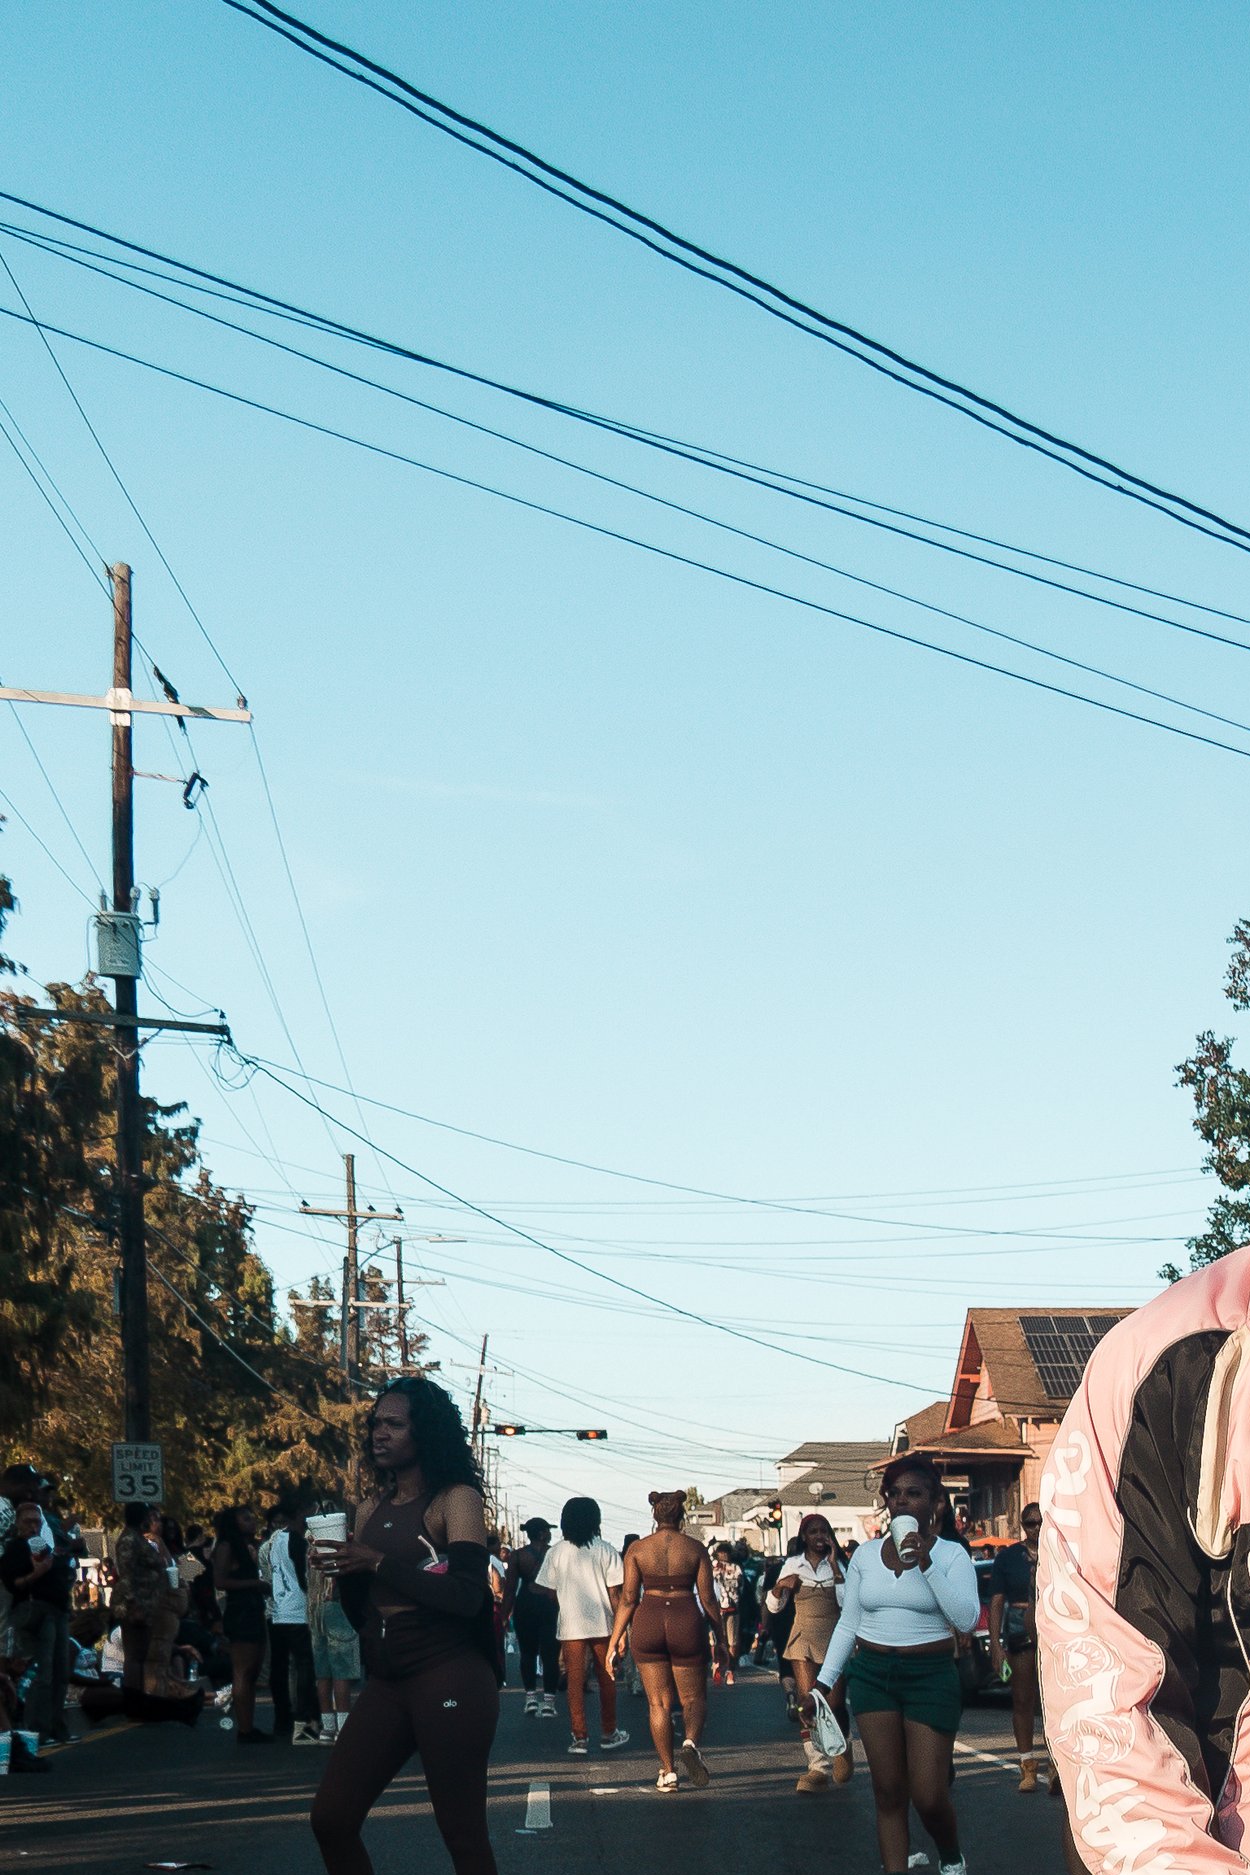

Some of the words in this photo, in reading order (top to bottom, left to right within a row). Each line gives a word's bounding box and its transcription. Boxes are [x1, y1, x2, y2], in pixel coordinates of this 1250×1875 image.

[116, 1448, 159, 1460] SPEED
[120, 1461, 154, 1472] LIMIT
[118, 1474, 160, 1496] 35
